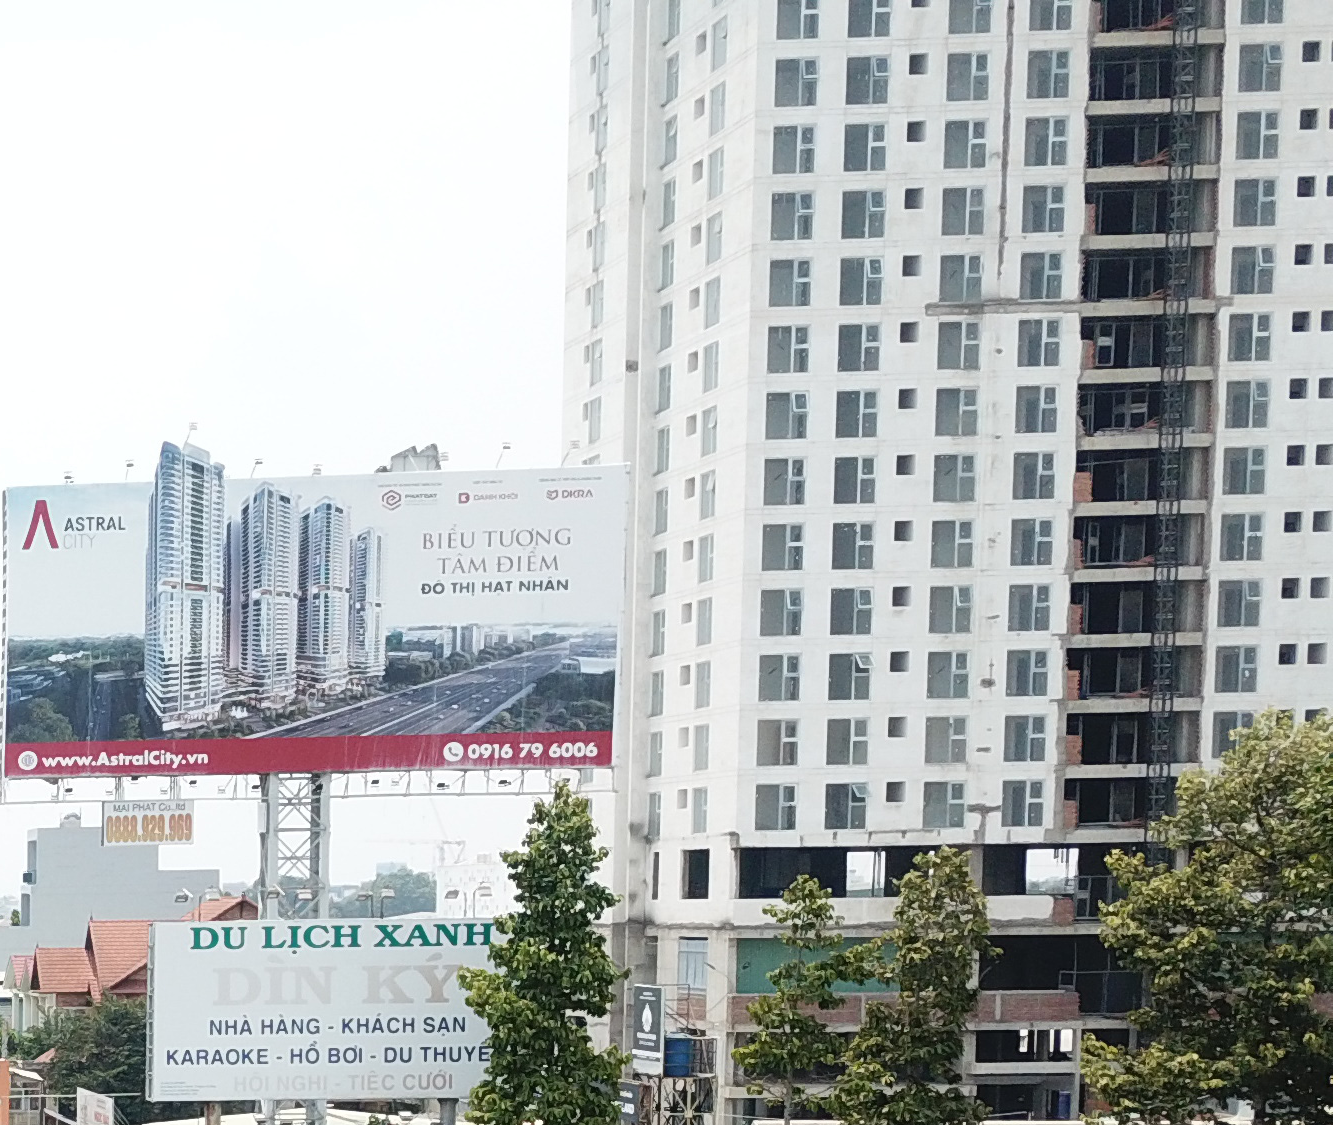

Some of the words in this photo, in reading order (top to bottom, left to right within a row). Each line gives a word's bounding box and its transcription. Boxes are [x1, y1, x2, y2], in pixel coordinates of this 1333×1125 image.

[561, 489, 594, 499] DKRA
[63, 516, 126, 532] ASTRAL
[63, 533, 97, 550] CITY
[422, 523, 476, 550] BIỂU
[483, 527, 572, 551] TƯỢNG
[437, 551, 487, 575] TÂM
[496, 546, 559, 574] ĐIỂM
[421, 579, 445, 595] ĐÔ
[451, 582, 476, 597] THỊ
[518, 576, 569, 593] NHÂN
[42, 750, 209, 768] www.AstralCity.vn
[467, 743, 514, 759] 0916
[519, 742, 544, 758] 79
[548, 741, 598, 758] 6006
[105, 812, 193, 844] 0888.929.969
[190, 926, 248, 950] DU
[261, 924, 363, 955] LỊCH
[374, 922, 495, 947] XANH
[212, 953, 338, 1007] DÌN
[209, 1014, 253, 1036] NHÀ
[261, 1013, 321, 1035] HÀNG
[341, 1012, 416, 1034] KHÁCH
[423, 1016, 466, 1038] SẠN
[166, 1048, 269, 1066] KARAOKE
[328, 1047, 363, 1065] BƠI
[384, 1045, 417, 1064] DU
[348, 1070, 396, 1093] TIỆC
[402, 1067, 453, 1091] CƯỚI
